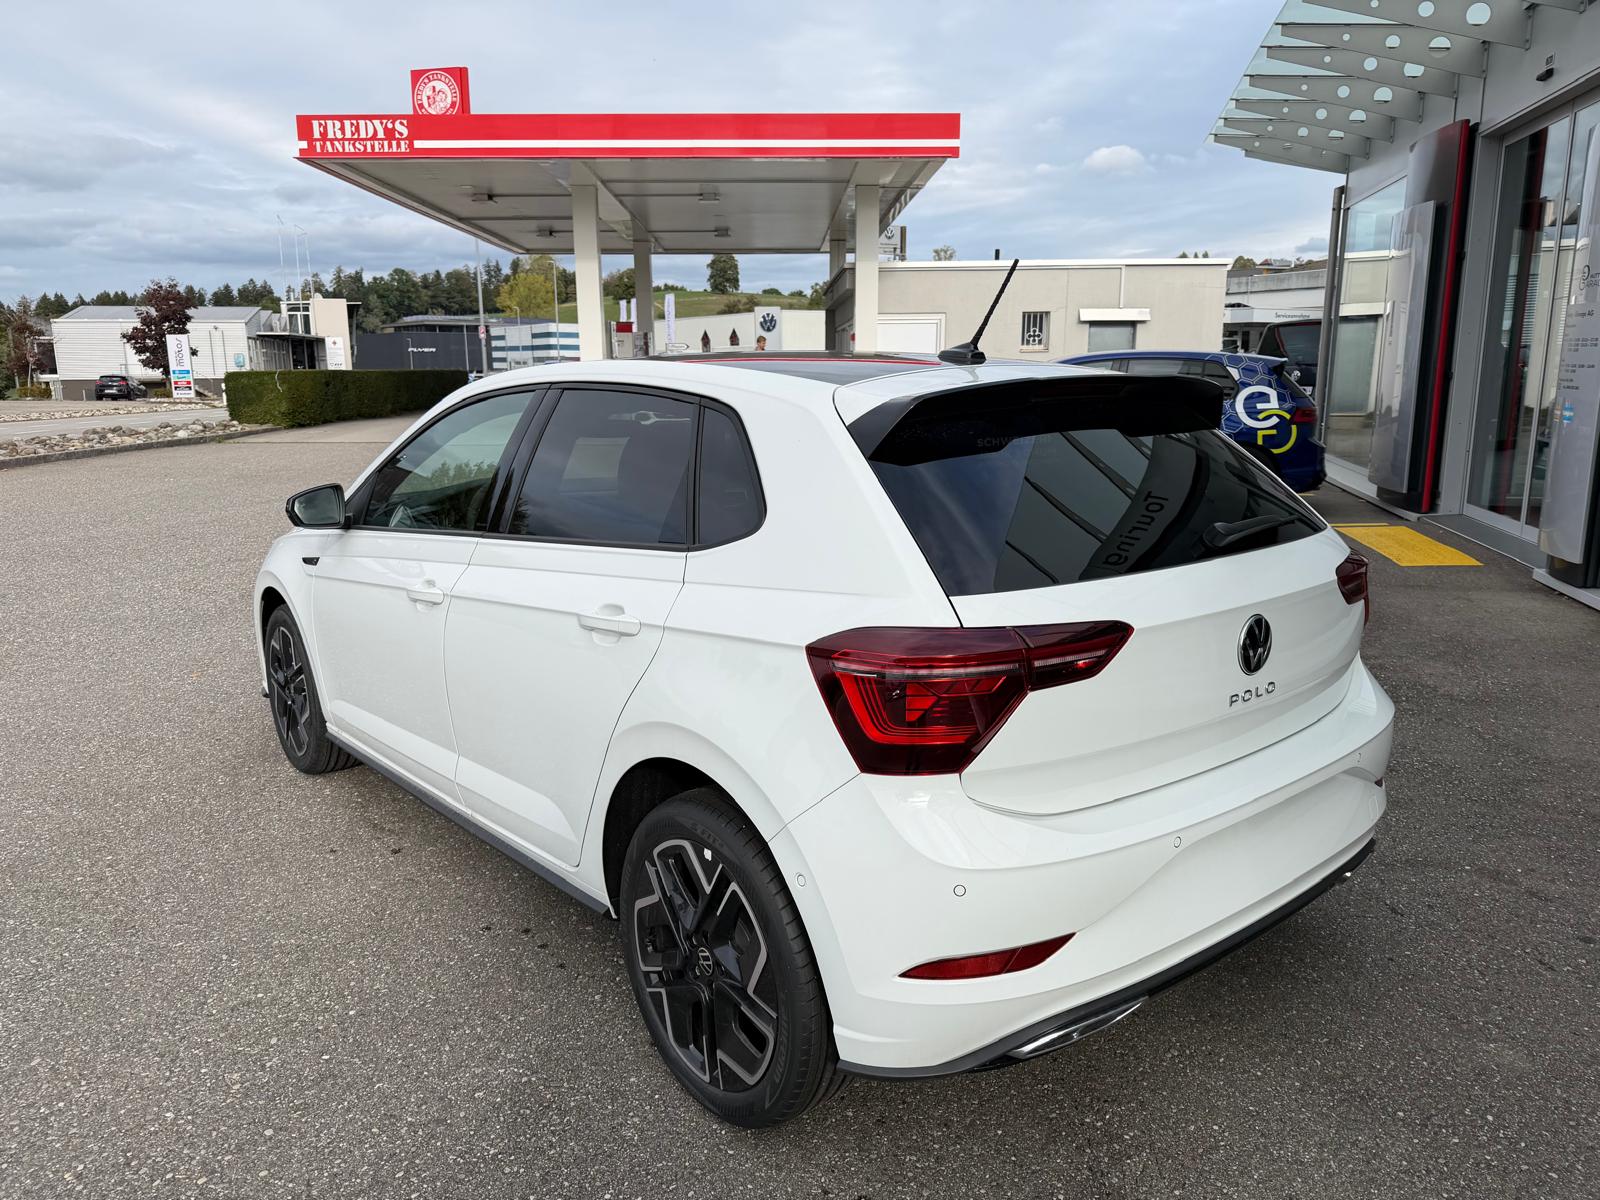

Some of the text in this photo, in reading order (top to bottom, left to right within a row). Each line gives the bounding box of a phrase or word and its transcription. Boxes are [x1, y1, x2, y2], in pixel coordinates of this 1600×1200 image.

[311, 118, 409, 139] FREDY'S
[313, 140, 410, 153] TANKSTELLE
[1229, 681, 1276, 707] POLO
